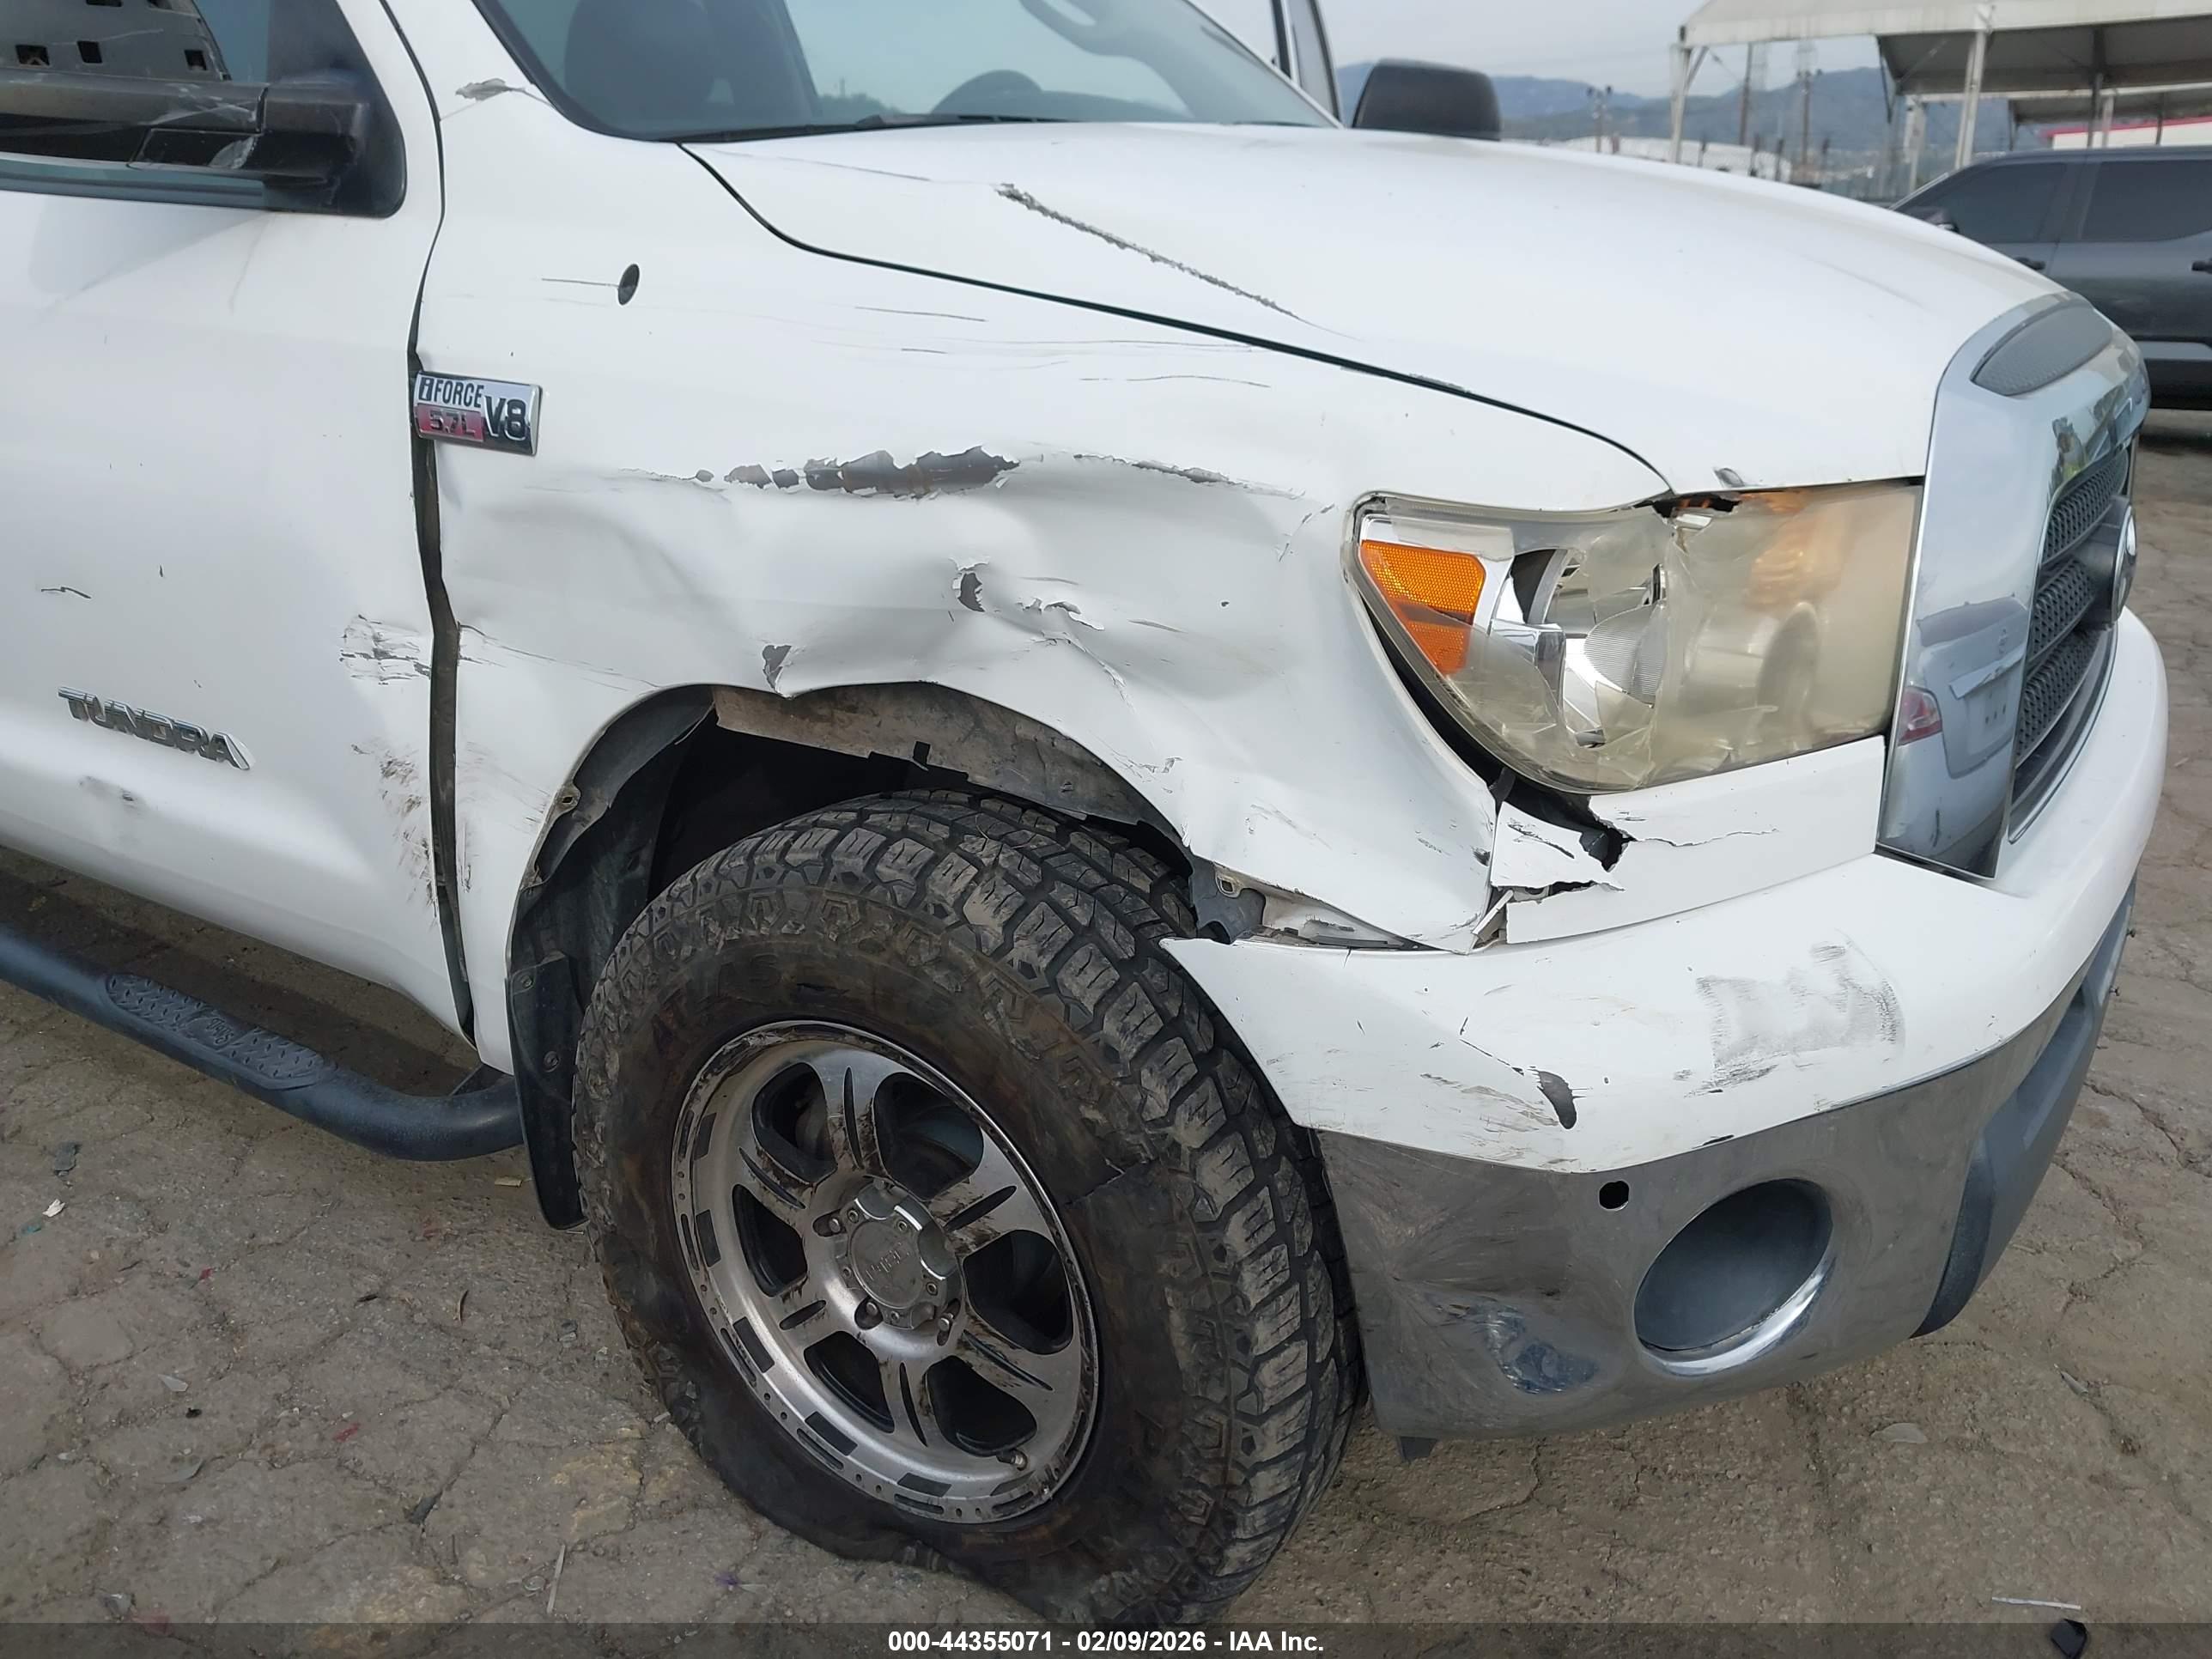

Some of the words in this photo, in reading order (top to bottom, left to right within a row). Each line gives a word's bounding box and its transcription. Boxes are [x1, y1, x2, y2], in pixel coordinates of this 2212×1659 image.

[429, 410, 477, 439] 5.7L
[483, 395, 527, 441] V8
[58, 686, 251, 770] TUNDRA
